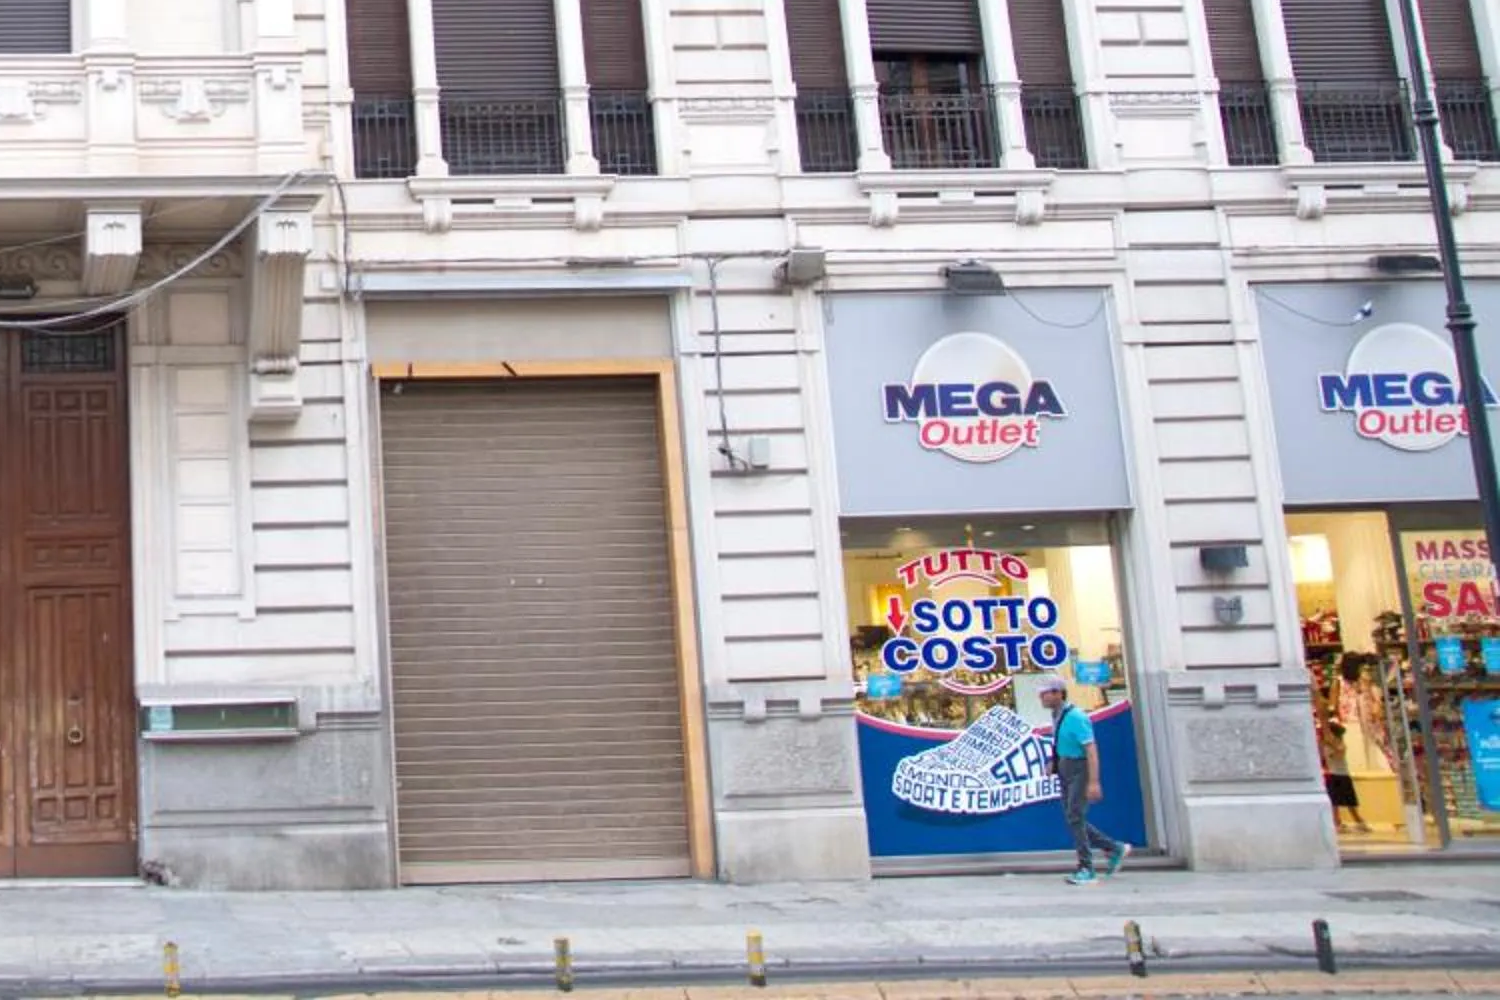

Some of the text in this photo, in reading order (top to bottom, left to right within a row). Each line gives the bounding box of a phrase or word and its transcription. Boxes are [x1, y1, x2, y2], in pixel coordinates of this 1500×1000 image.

[884, 379, 1065, 419] MEGA
[920, 417, 1039, 447] Outlet
[1359, 408, 1470, 435] Outlet
[899, 549, 1029, 586] TUTTO
[912, 597, 1058, 633] SOTTO
[1423, 581, 1499, 618] SA
[883, 633, 1068, 673] COSTO
[895, 775, 948, 809] SPORT
[951, 790, 961, 809] E
[966, 783, 1021, 809] TEMPO
